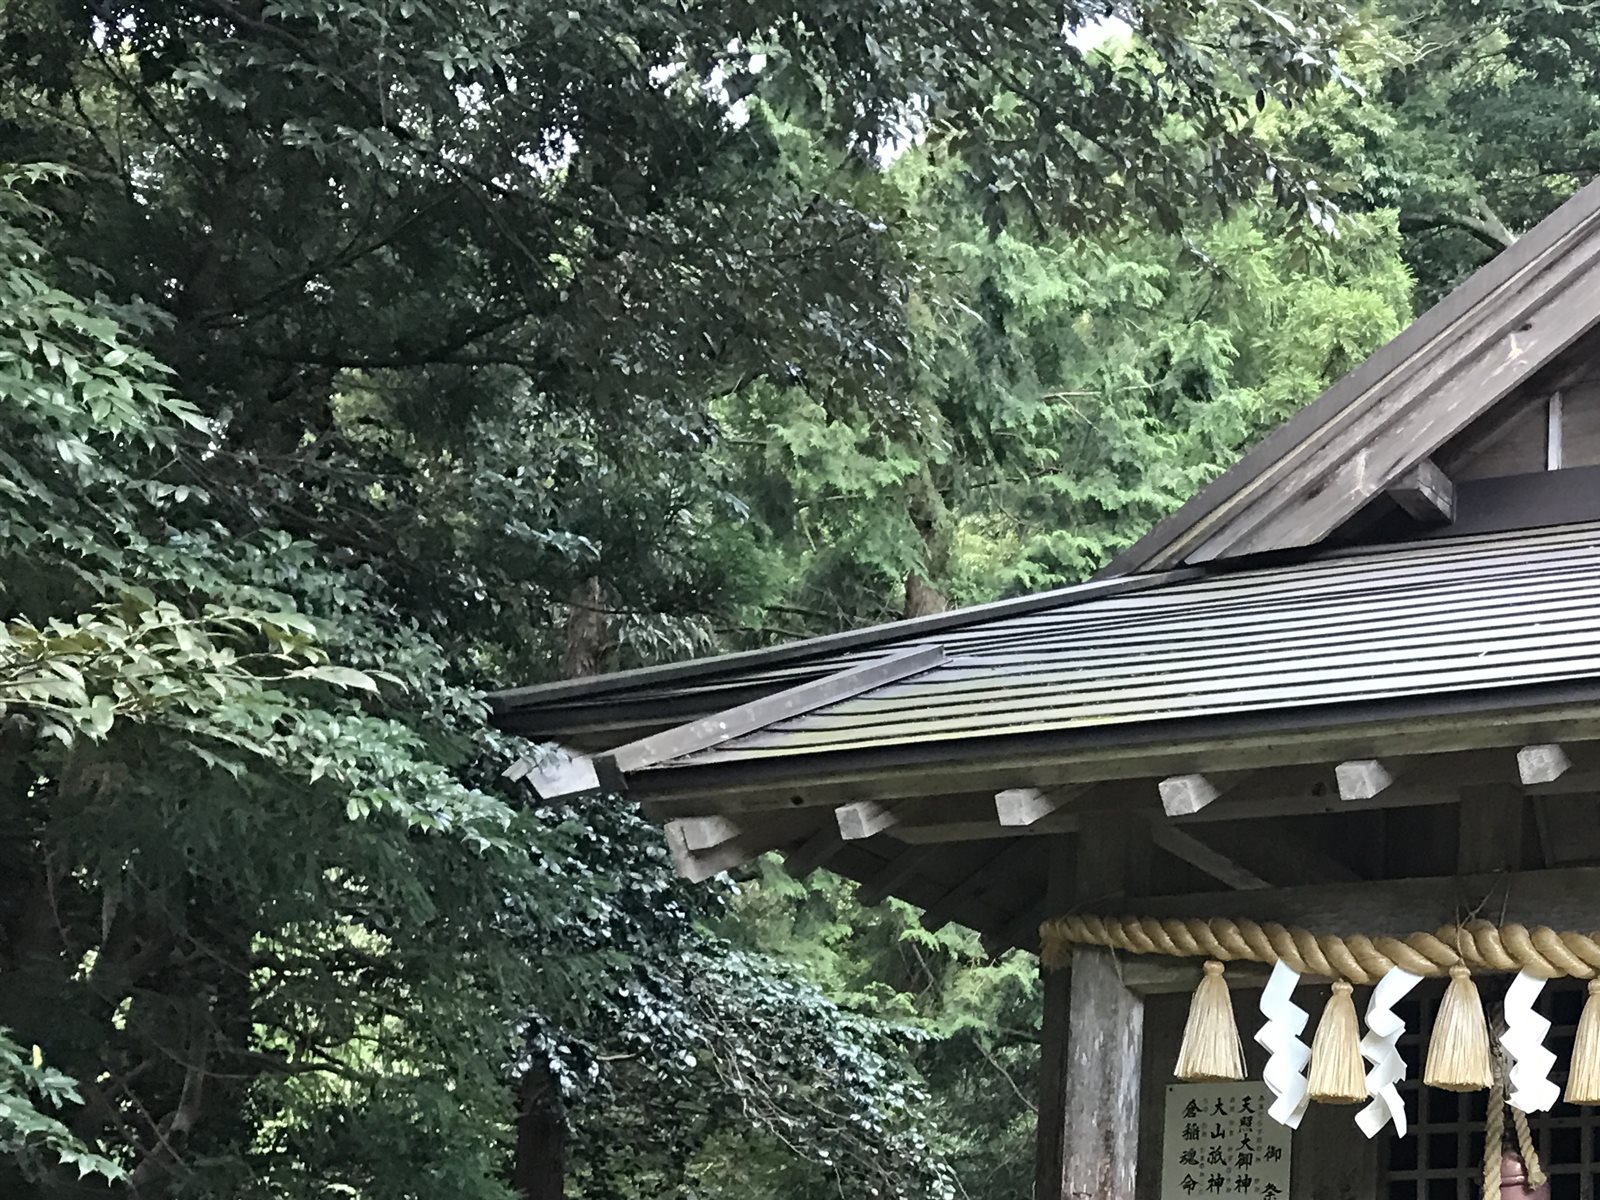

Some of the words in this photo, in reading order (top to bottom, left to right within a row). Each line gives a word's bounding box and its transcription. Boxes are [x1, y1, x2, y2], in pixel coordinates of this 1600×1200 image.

[1179, 1098, 1202, 1196] 倉稲魂命
[1234, 1096, 1256, 1195] 天照大御神
